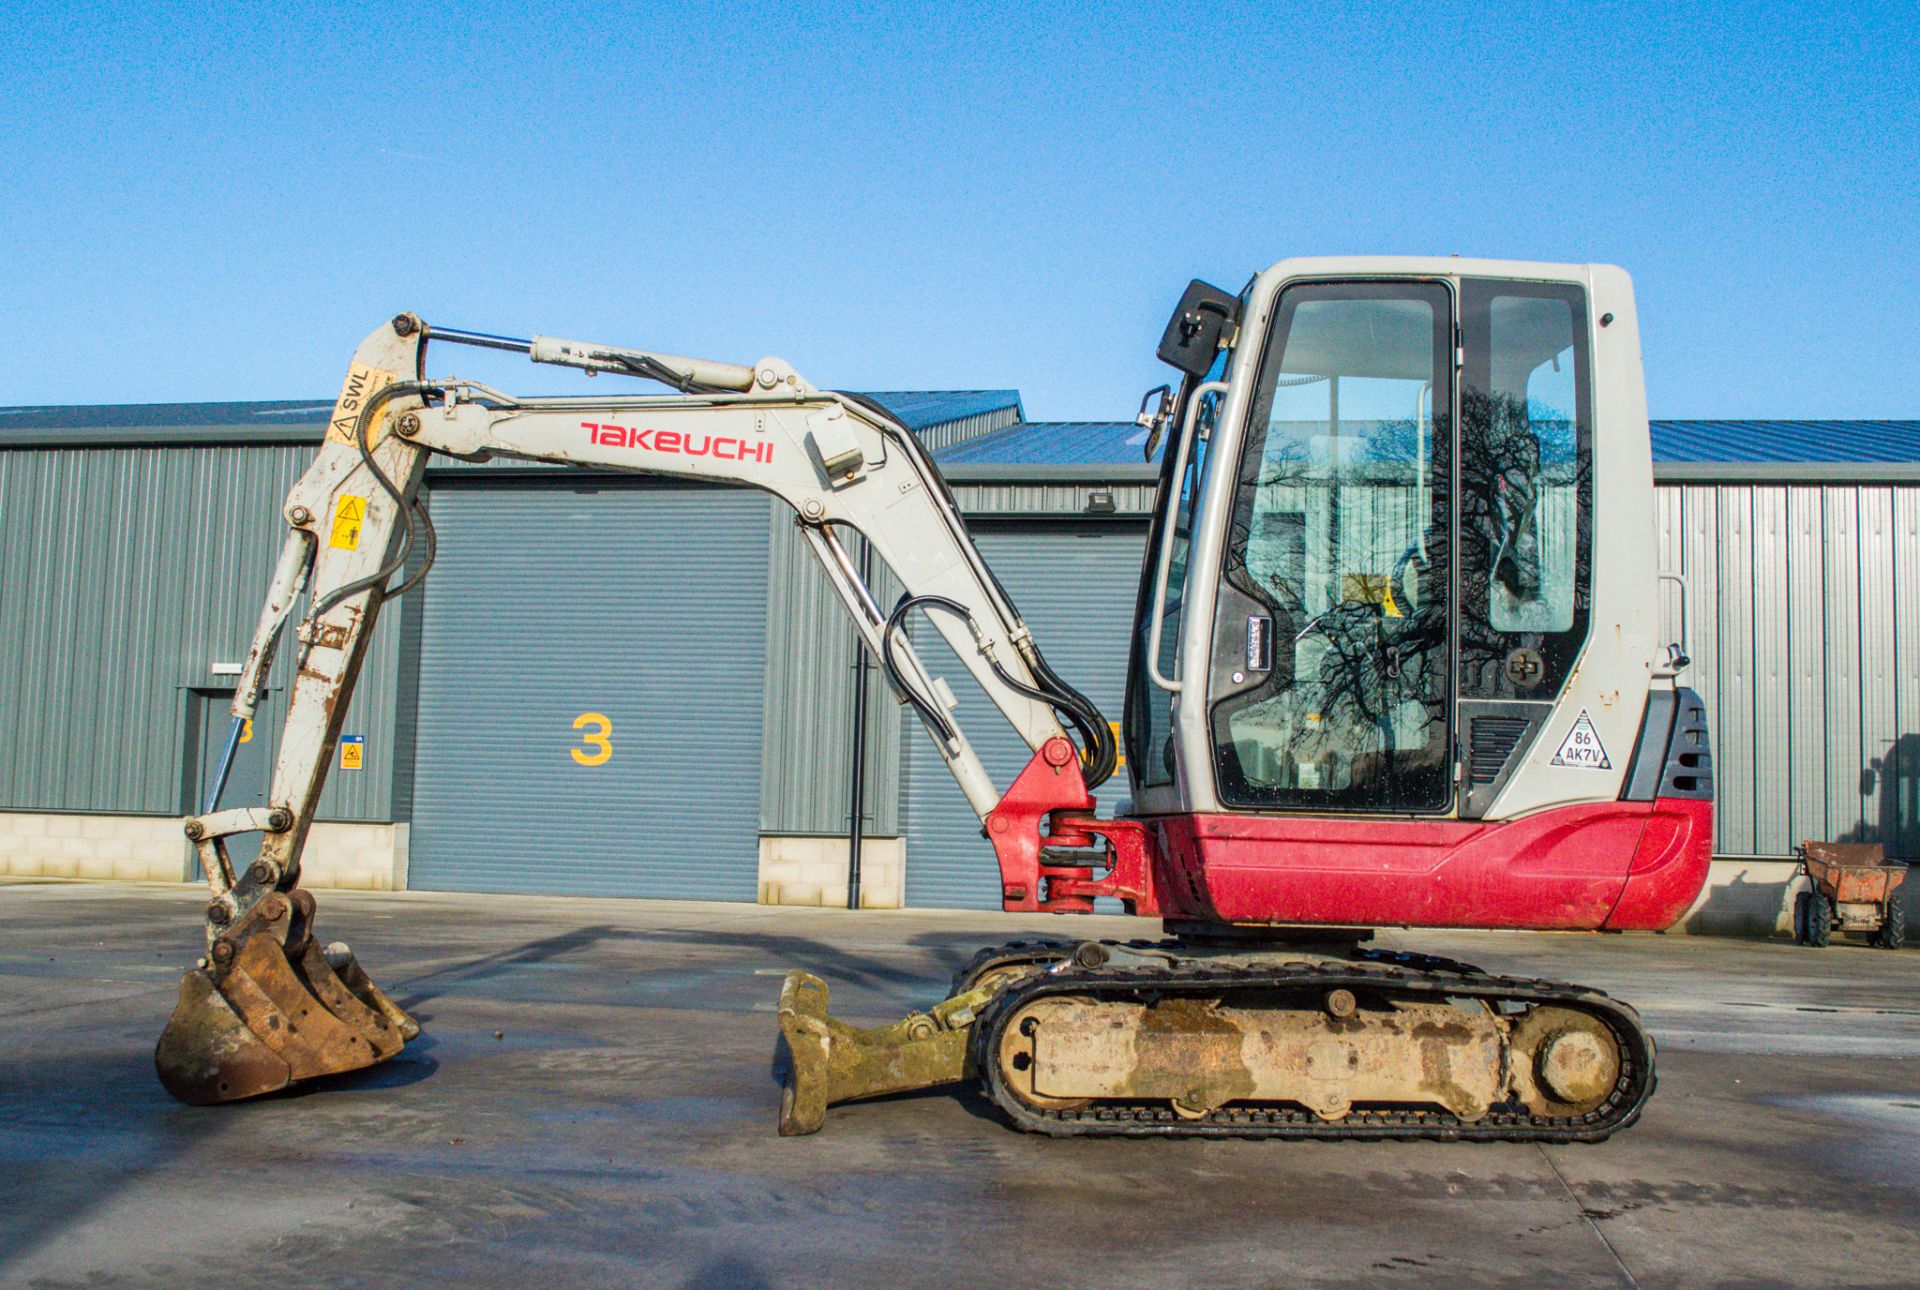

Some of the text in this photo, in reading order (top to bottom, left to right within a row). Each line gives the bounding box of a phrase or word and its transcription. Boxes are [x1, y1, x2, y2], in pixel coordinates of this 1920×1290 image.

[343, 370, 369, 411] SWL
[570, 712, 613, 767] 3
[1575, 732, 1591, 745] 86
[1566, 747, 1600, 762] AK7V
